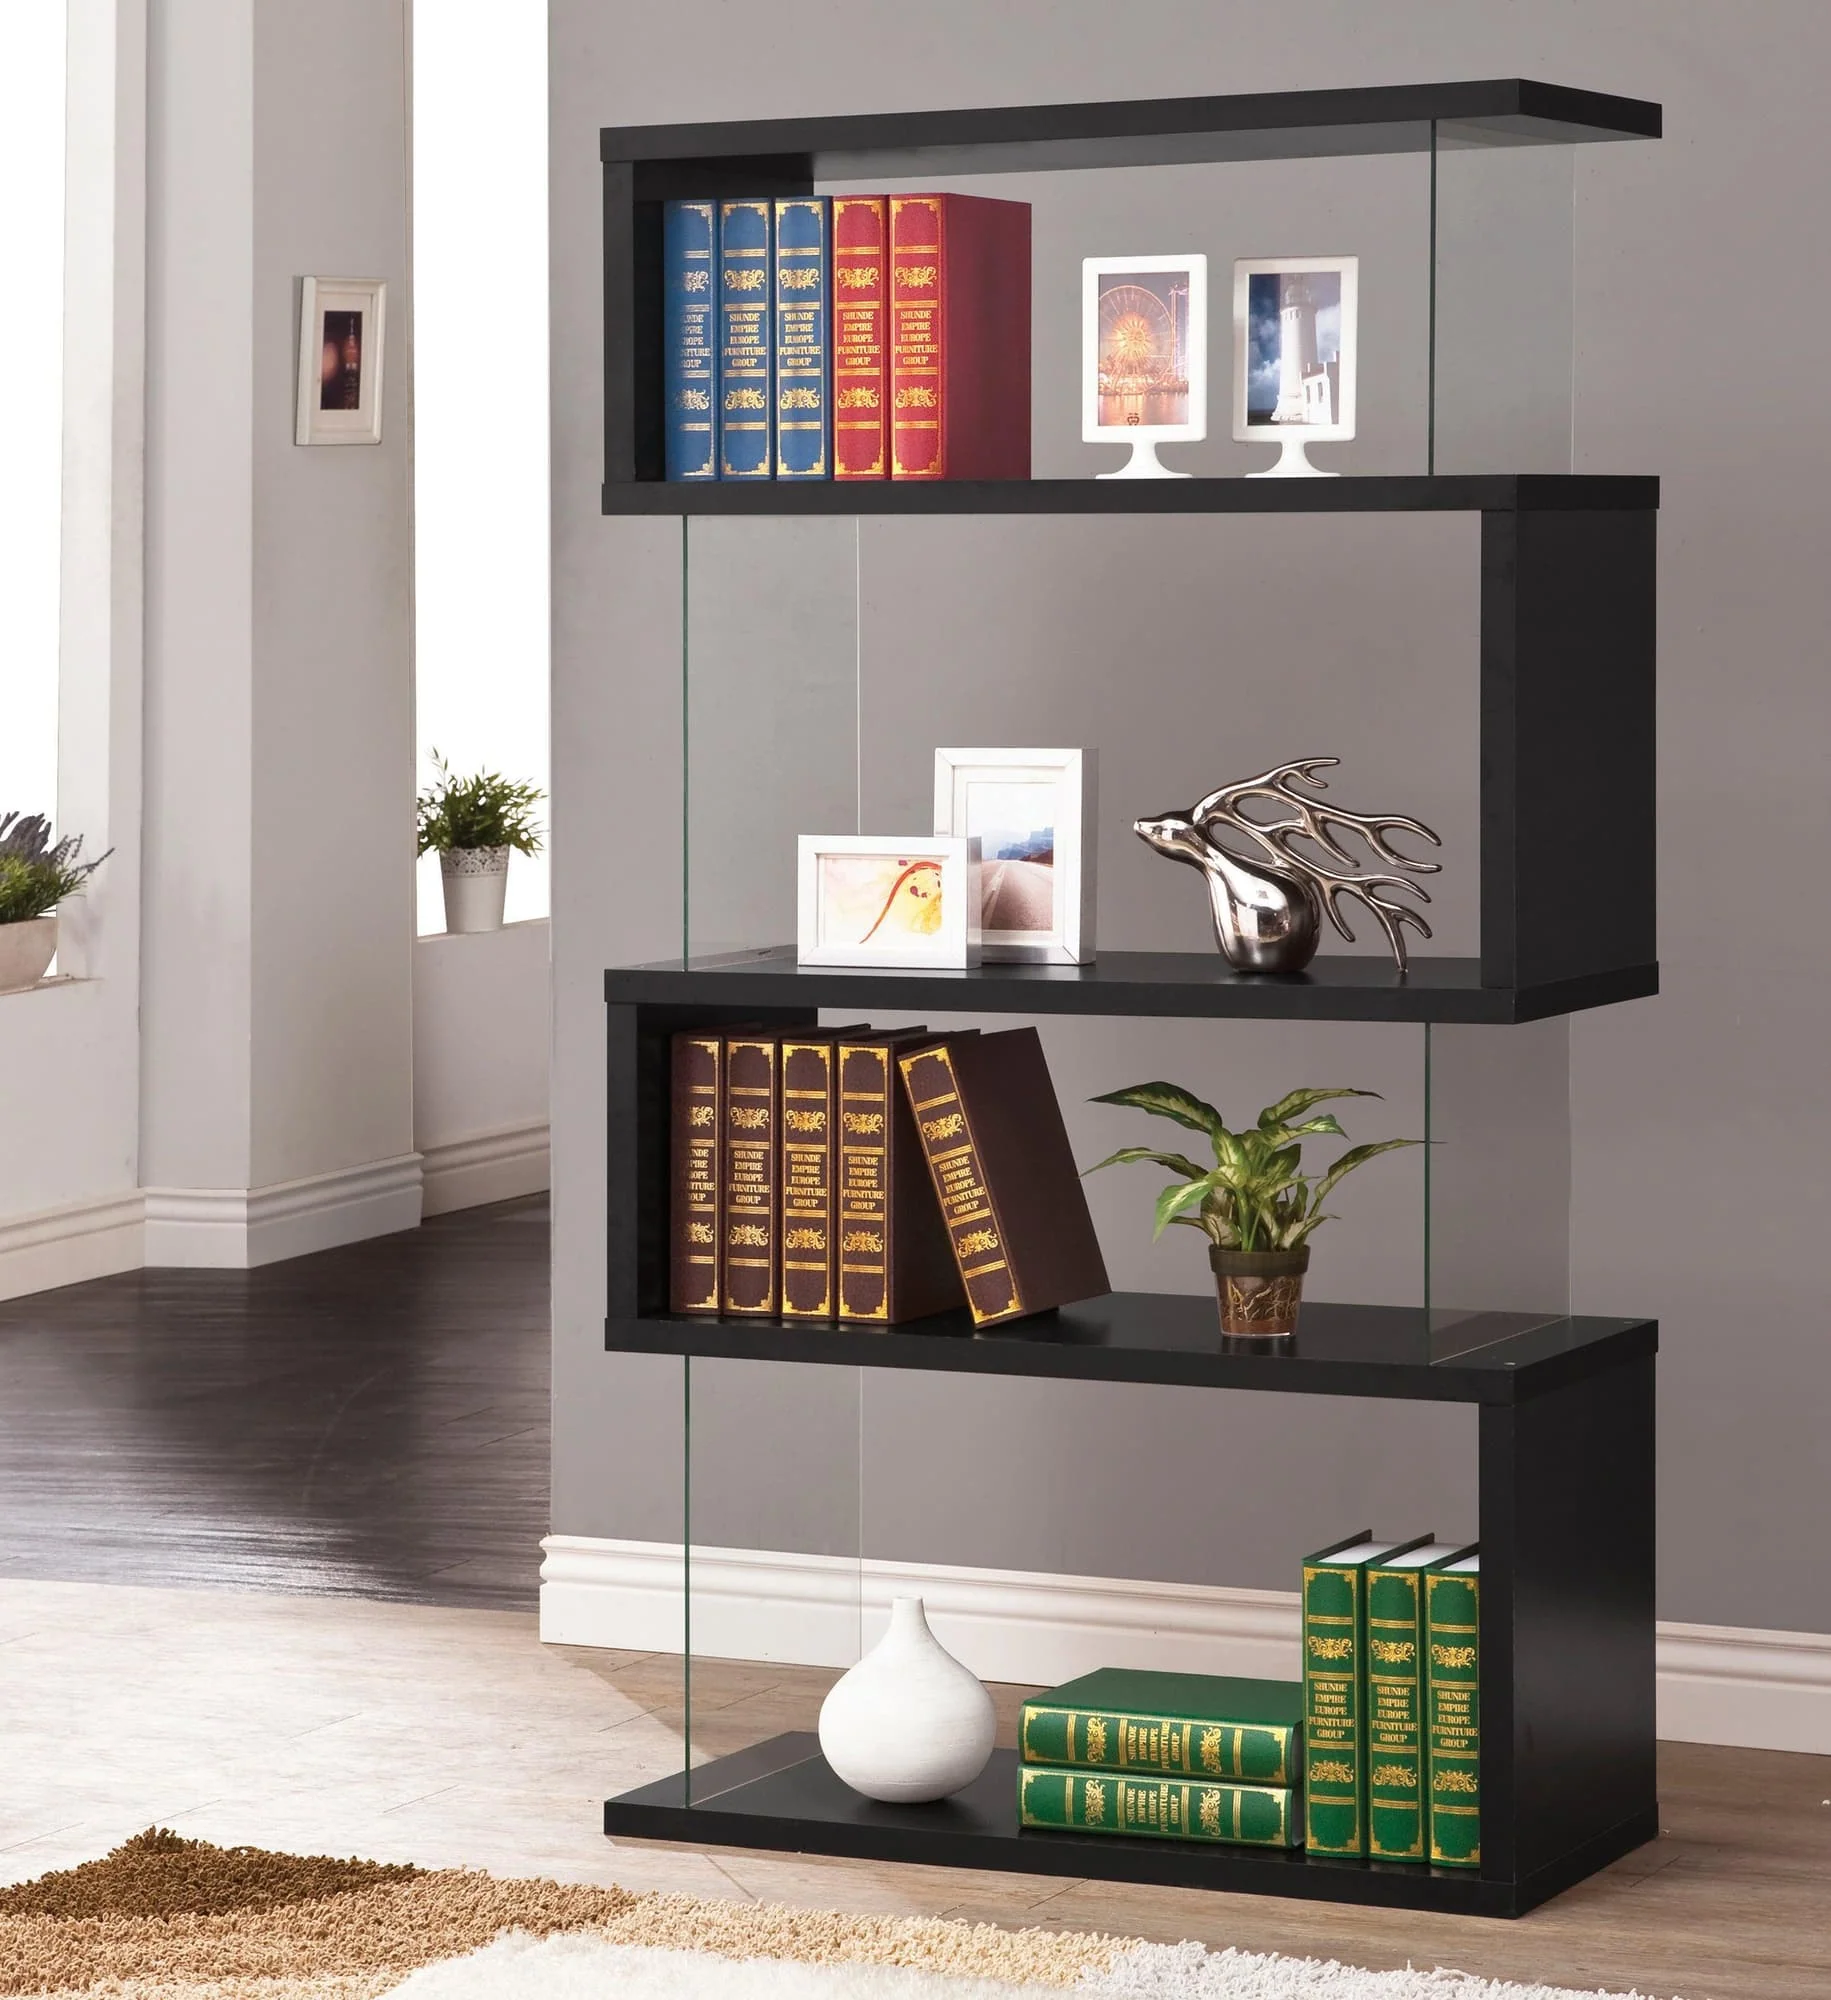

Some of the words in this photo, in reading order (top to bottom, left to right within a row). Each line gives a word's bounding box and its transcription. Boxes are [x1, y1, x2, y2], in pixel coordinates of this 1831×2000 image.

[729, 312, 760, 322] SHUNDE
[784, 311, 815, 321] SHUNDE
[842, 311, 874, 320] SHUNDE
[900, 310, 932, 319] SHUNDE
[730, 324, 759, 333] EMPIRE
[785, 323, 814, 332] EMPIRE
[843, 322, 873, 331] EMPIRE
[901, 321, 931, 331] EMPIRE
[730, 335, 760, 344] EUROPE
[785, 334, 815, 343] EUROPE
[843, 333, 873, 342] EUROPE
[900, 333, 931, 342] EUROPE
[725, 346, 767, 356] FURNITURE
[780, 345, 821, 355] FURNITURE
[837, 345, 880, 354] FURNITURE
[895, 344, 937, 353] FURNITURE
[732, 358, 757, 367] GROUP
[787, 357, 812, 366] GROUP
[845, 356, 871, 365] GROUP
[902, 355, 928, 365] GROUP
[733, 1151, 764, 1160] SHUNDE
[791, 1153, 821, 1163] SHUNDE
[734, 1161, 763, 1171] EMPIRE
[848, 1156, 878, 1166] SHUNDE
[939, 1155, 970, 1172] SHUNDE
[791, 1164, 820, 1174] EMPIRE
[849, 1167, 878, 1177] EMPIRE
[734, 1172, 764, 1182] EUROPE
[791, 1175, 820, 1185] EUROPE
[942, 1167, 972, 1183] EMPIRE
[728, 1183, 770, 1193] FURNITURE
[848, 1178, 878, 1188] EUROPE
[945, 1177, 976, 1194] EUROPE
[786, 1186, 827, 1197] FURNITURE
[842, 1189, 884, 1200] FURNITURE
[943, 1186, 986, 1207] FURNITURE
[735, 1194, 761, 1205] GROUP
[793, 1198, 818, 1208] GROUP
[850, 1201, 876, 1210] GROUP
[953, 1200, 979, 1215] GROUP
[1314, 1682, 1348, 1693] SHUNDE
[1376, 1685, 1410, 1697] SHUNDE
[1315, 1694, 1347, 1704] EMPIRE
[1436, 1690, 1471, 1701] SHUNDE
[1377, 1697, 1409, 1708] EMPIRE
[1437, 1702, 1470, 1713] EMPIRE
[1314, 1705, 1347, 1716] EUROPE
[1377, 1709, 1410, 1720] EUROPE
[1308, 1715, 1355, 1728] FURNITURE
[1437, 1714, 1471, 1725] EUROPE
[1371, 1719, 1417, 1732] FURNITURE
[1316, 1729, 1345, 1739] GROUP
[1431, 1725, 1478, 1737] FURNITURE
[1379, 1732, 1408, 1743] GROUP
[1128, 1726, 1137, 1760] SHUNDE
[1138, 1727, 1148, 1760] EMPIRE
[1150, 1727, 1159, 1761] EUROPE
[1161, 1720, 1170, 1769] FURNITURE
[1171, 1732, 1180, 1761] GROUP
[1440, 1737, 1469, 1749] GROUP
[1127, 1788, 1136, 1823] SHUNDE
[1138, 1789, 1147, 1823] EMPIRE
[1149, 1790, 1158, 1824] EUROPE
[1160, 1783, 1169, 1832] FURNITURE
[1171, 1794, 1179, 1824] GROUP
